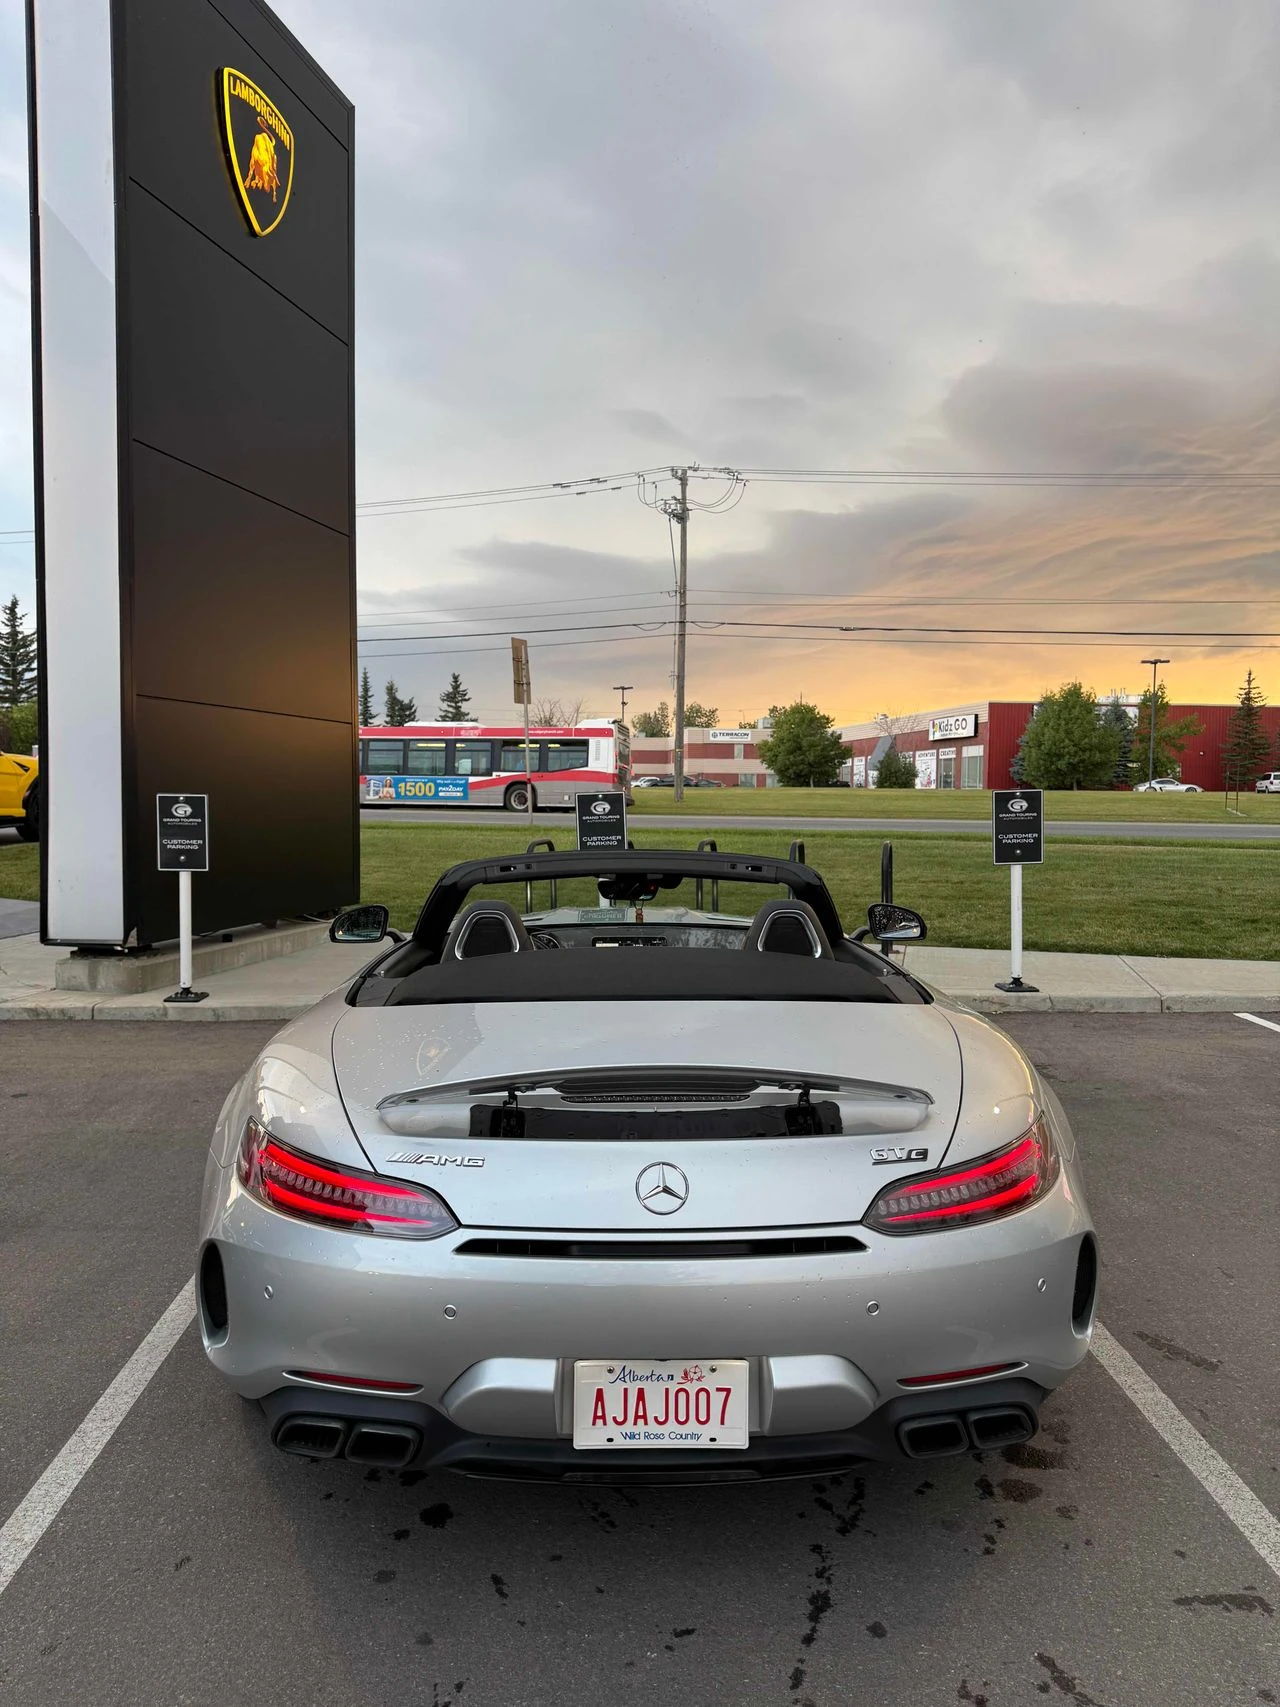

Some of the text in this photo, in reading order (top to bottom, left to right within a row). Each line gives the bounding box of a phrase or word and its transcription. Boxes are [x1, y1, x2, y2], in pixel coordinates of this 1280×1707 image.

[230, 75, 290, 150] LAMBORGHINI
[938, 717, 968, 732] Kidz GO
[608, 1364, 667, 1384] Alberta
[591, 1387, 733, 1426] AJAJ007
[620, 1431, 703, 1442] Wild Rose Country
